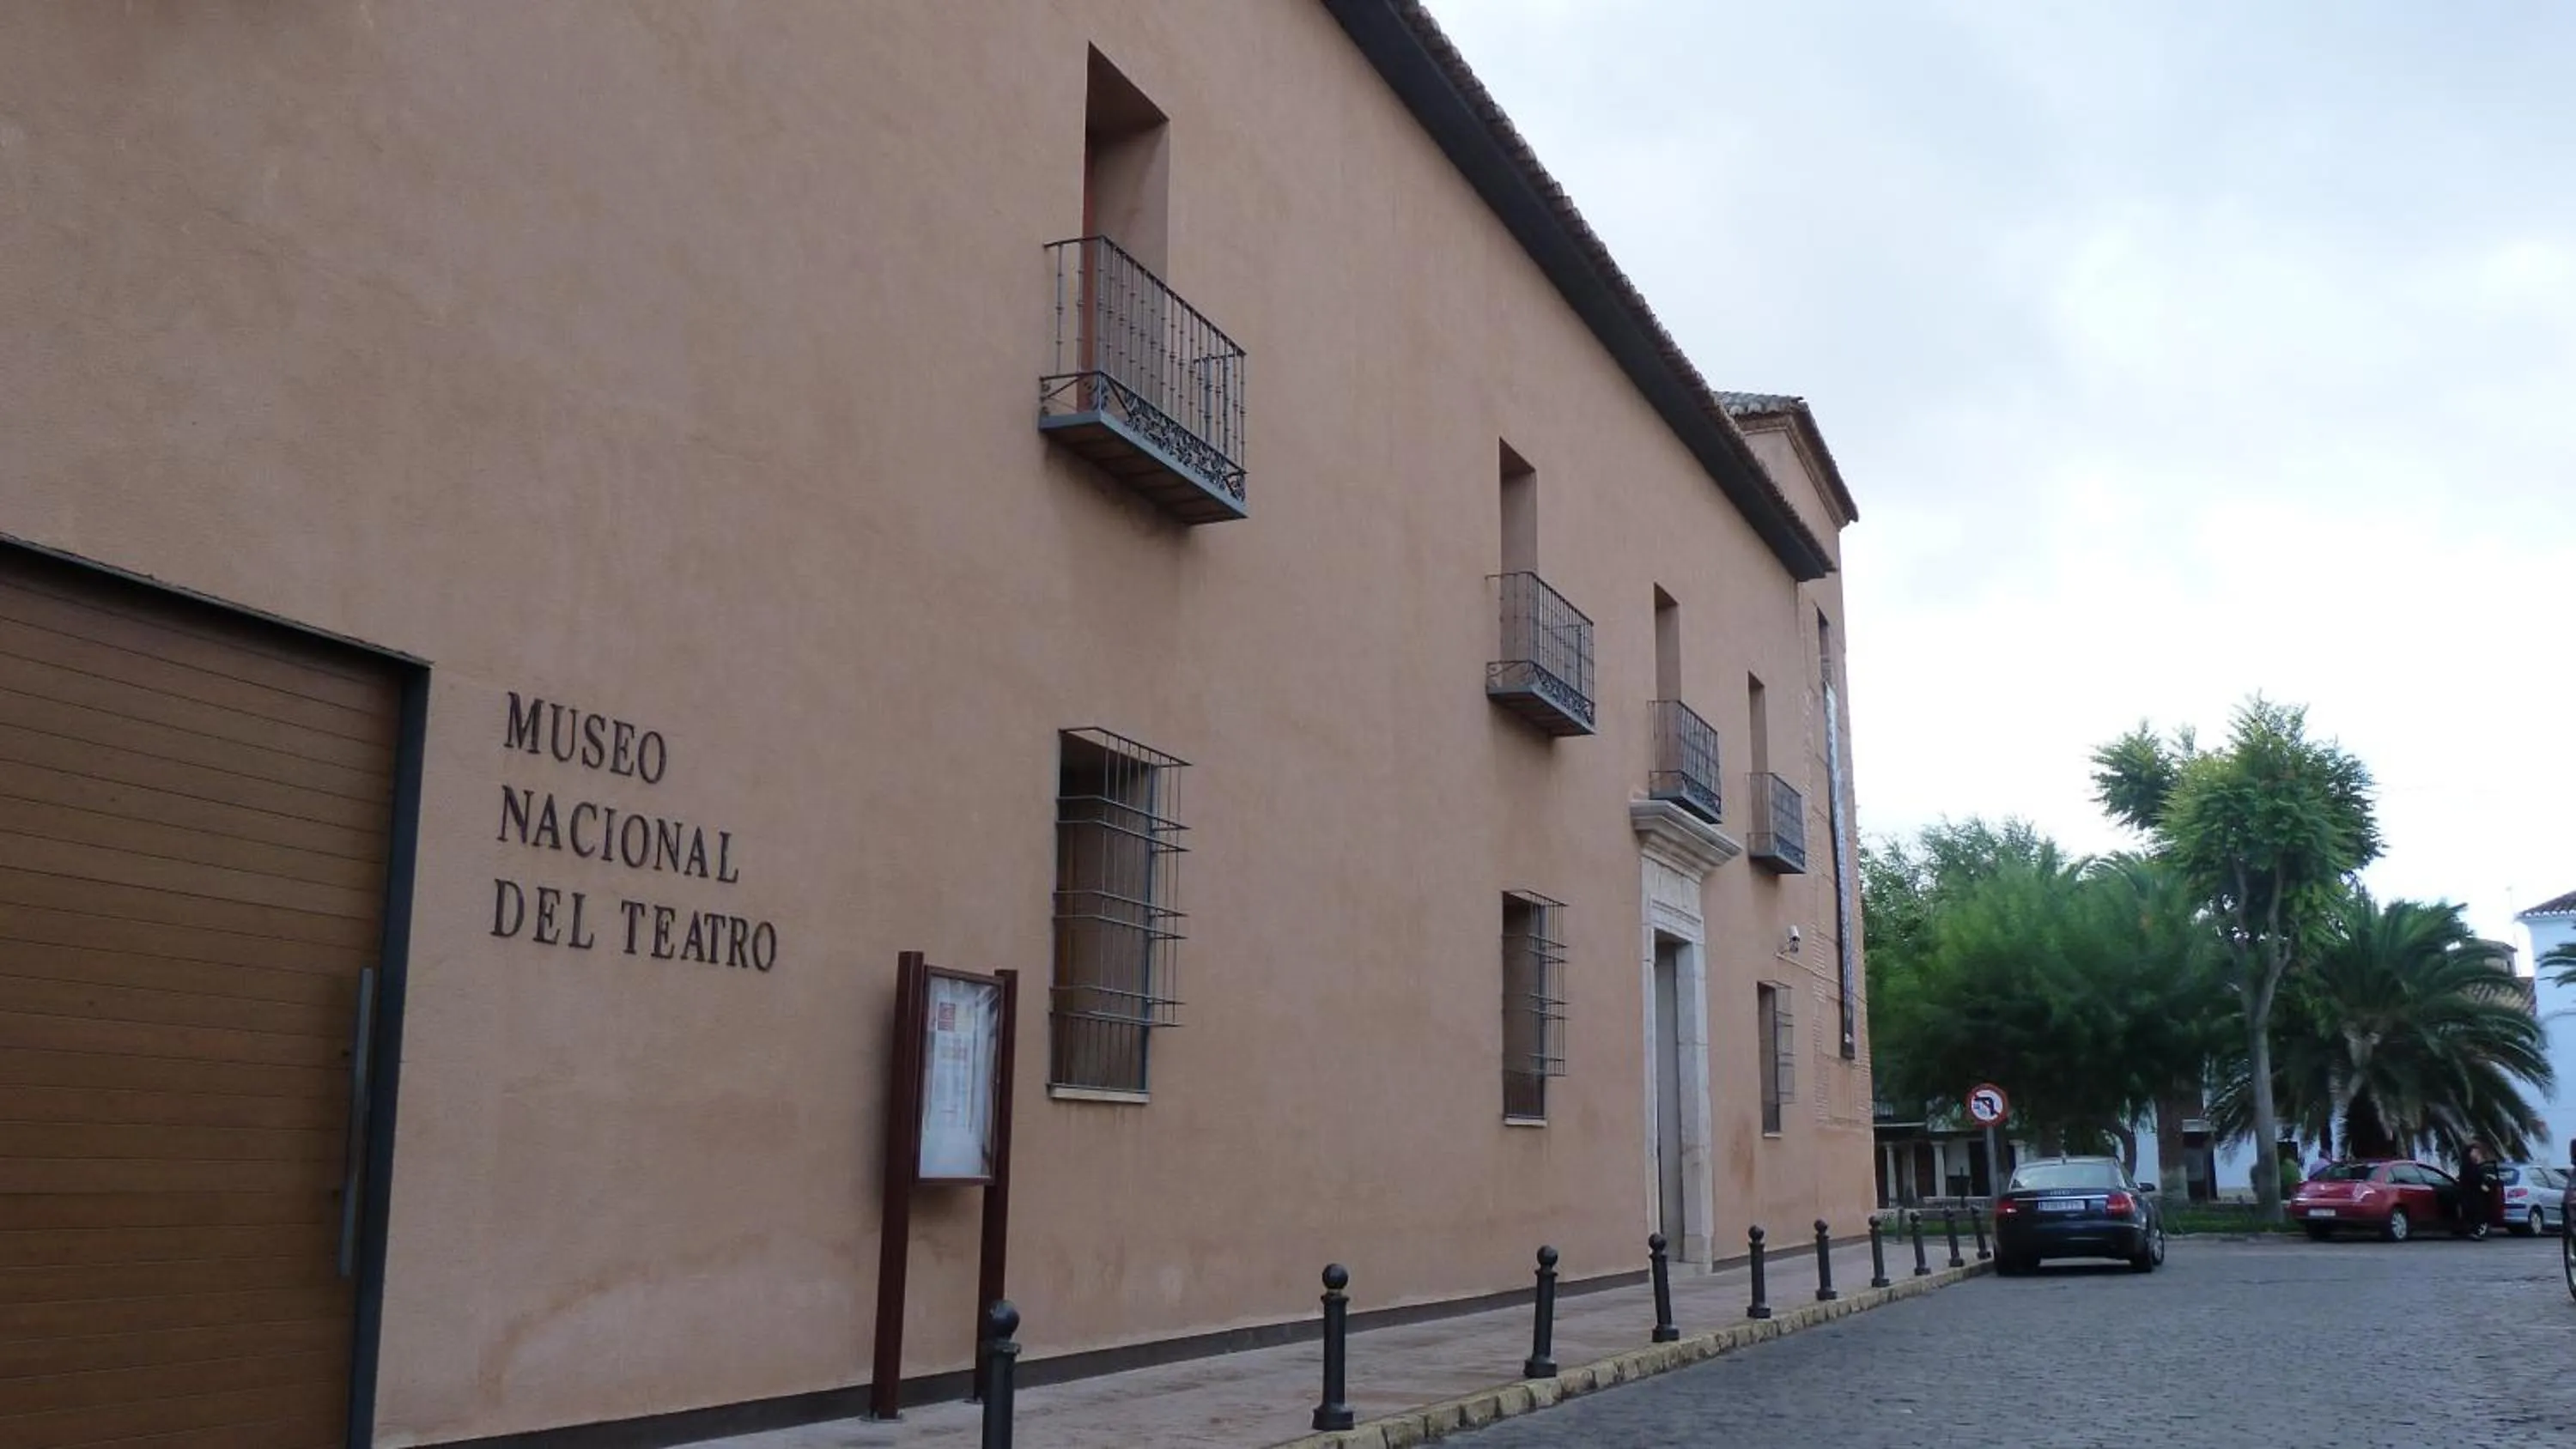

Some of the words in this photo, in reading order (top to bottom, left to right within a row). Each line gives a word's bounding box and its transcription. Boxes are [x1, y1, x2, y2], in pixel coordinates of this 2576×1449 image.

[504, 691, 666, 784] MUSEO
[497, 785, 739, 883] NACIONAL
[490, 878, 594, 949] DEL
[620, 899, 777, 973] TEATRO
